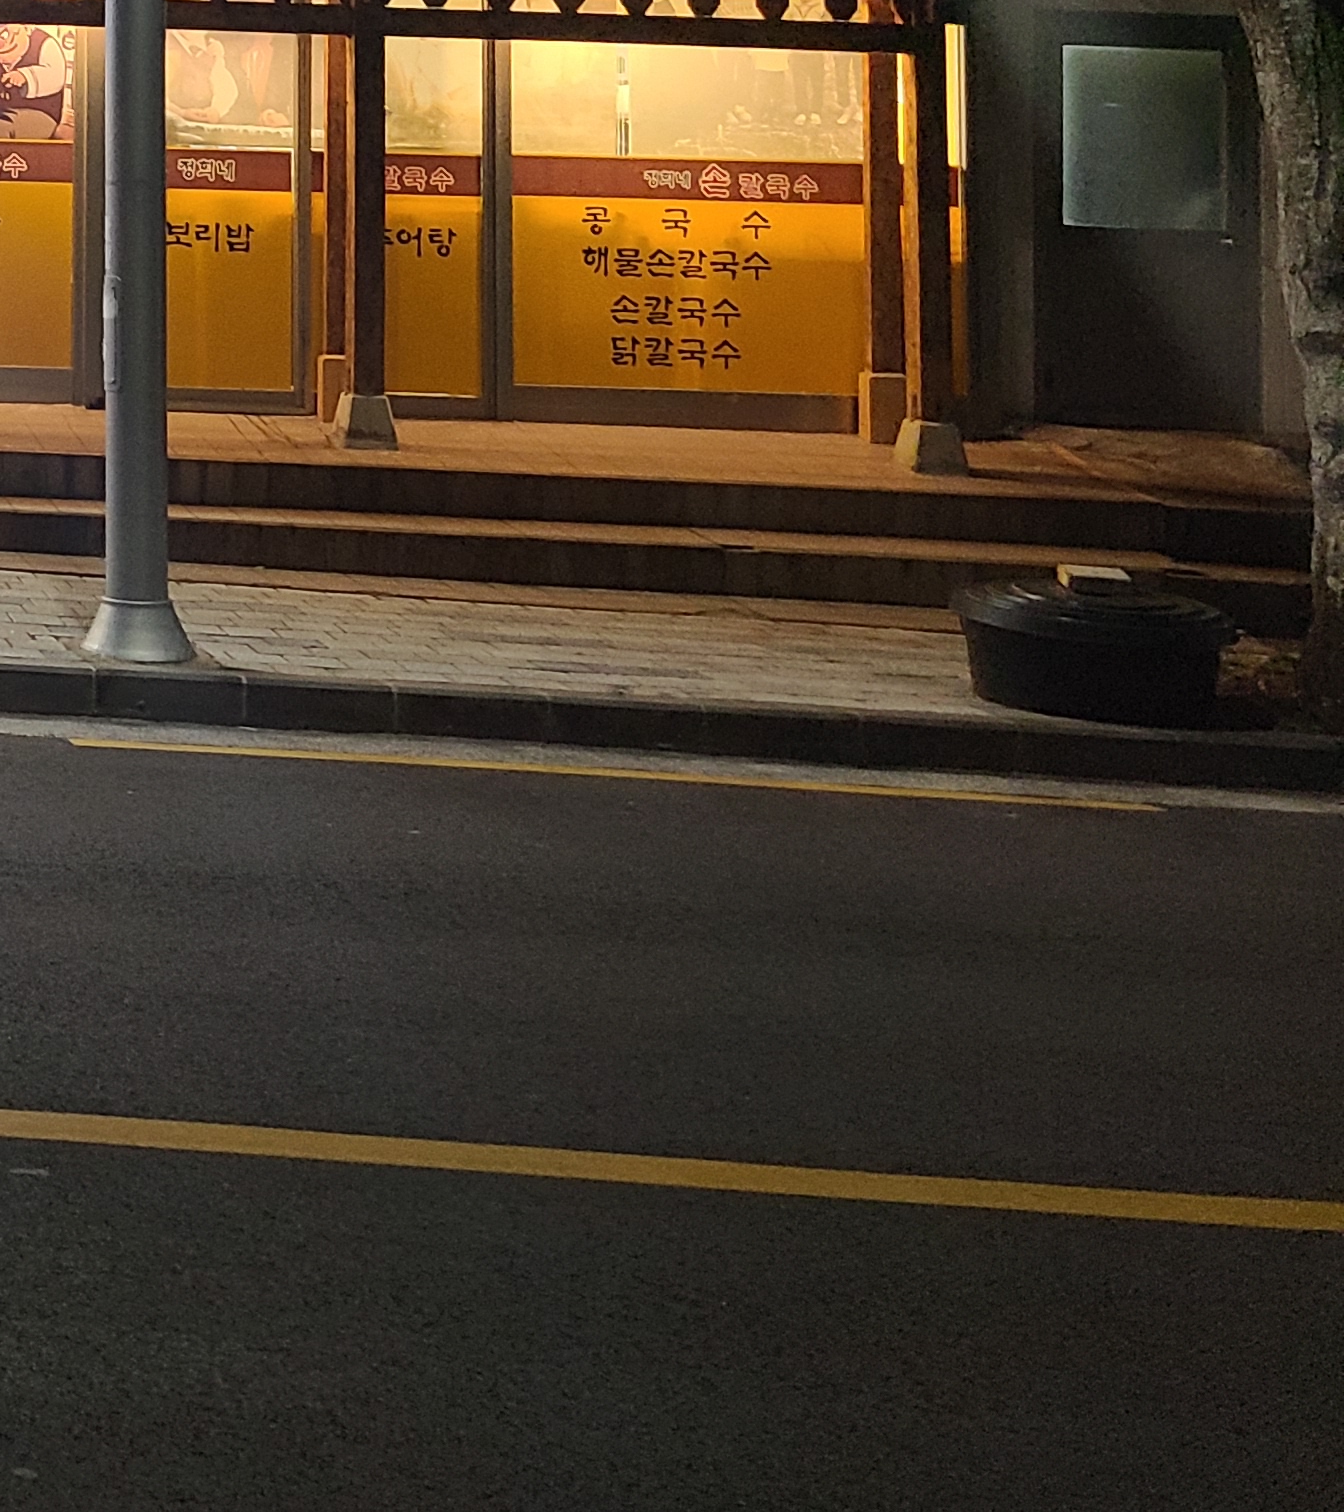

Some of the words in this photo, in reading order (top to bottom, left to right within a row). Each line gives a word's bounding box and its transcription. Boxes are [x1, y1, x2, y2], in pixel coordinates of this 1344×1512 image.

[177, 158, 236, 183] 정희네
[643, 169, 691, 190] 정희네
[737, 173, 819, 200] 칼국수
[165, 222, 255, 253] 보리밥
[581, 246, 773, 281] 해물손칼국수
[610, 294, 743, 327] 손칼국수
[610, 335, 743, 368] 닭칼국수
